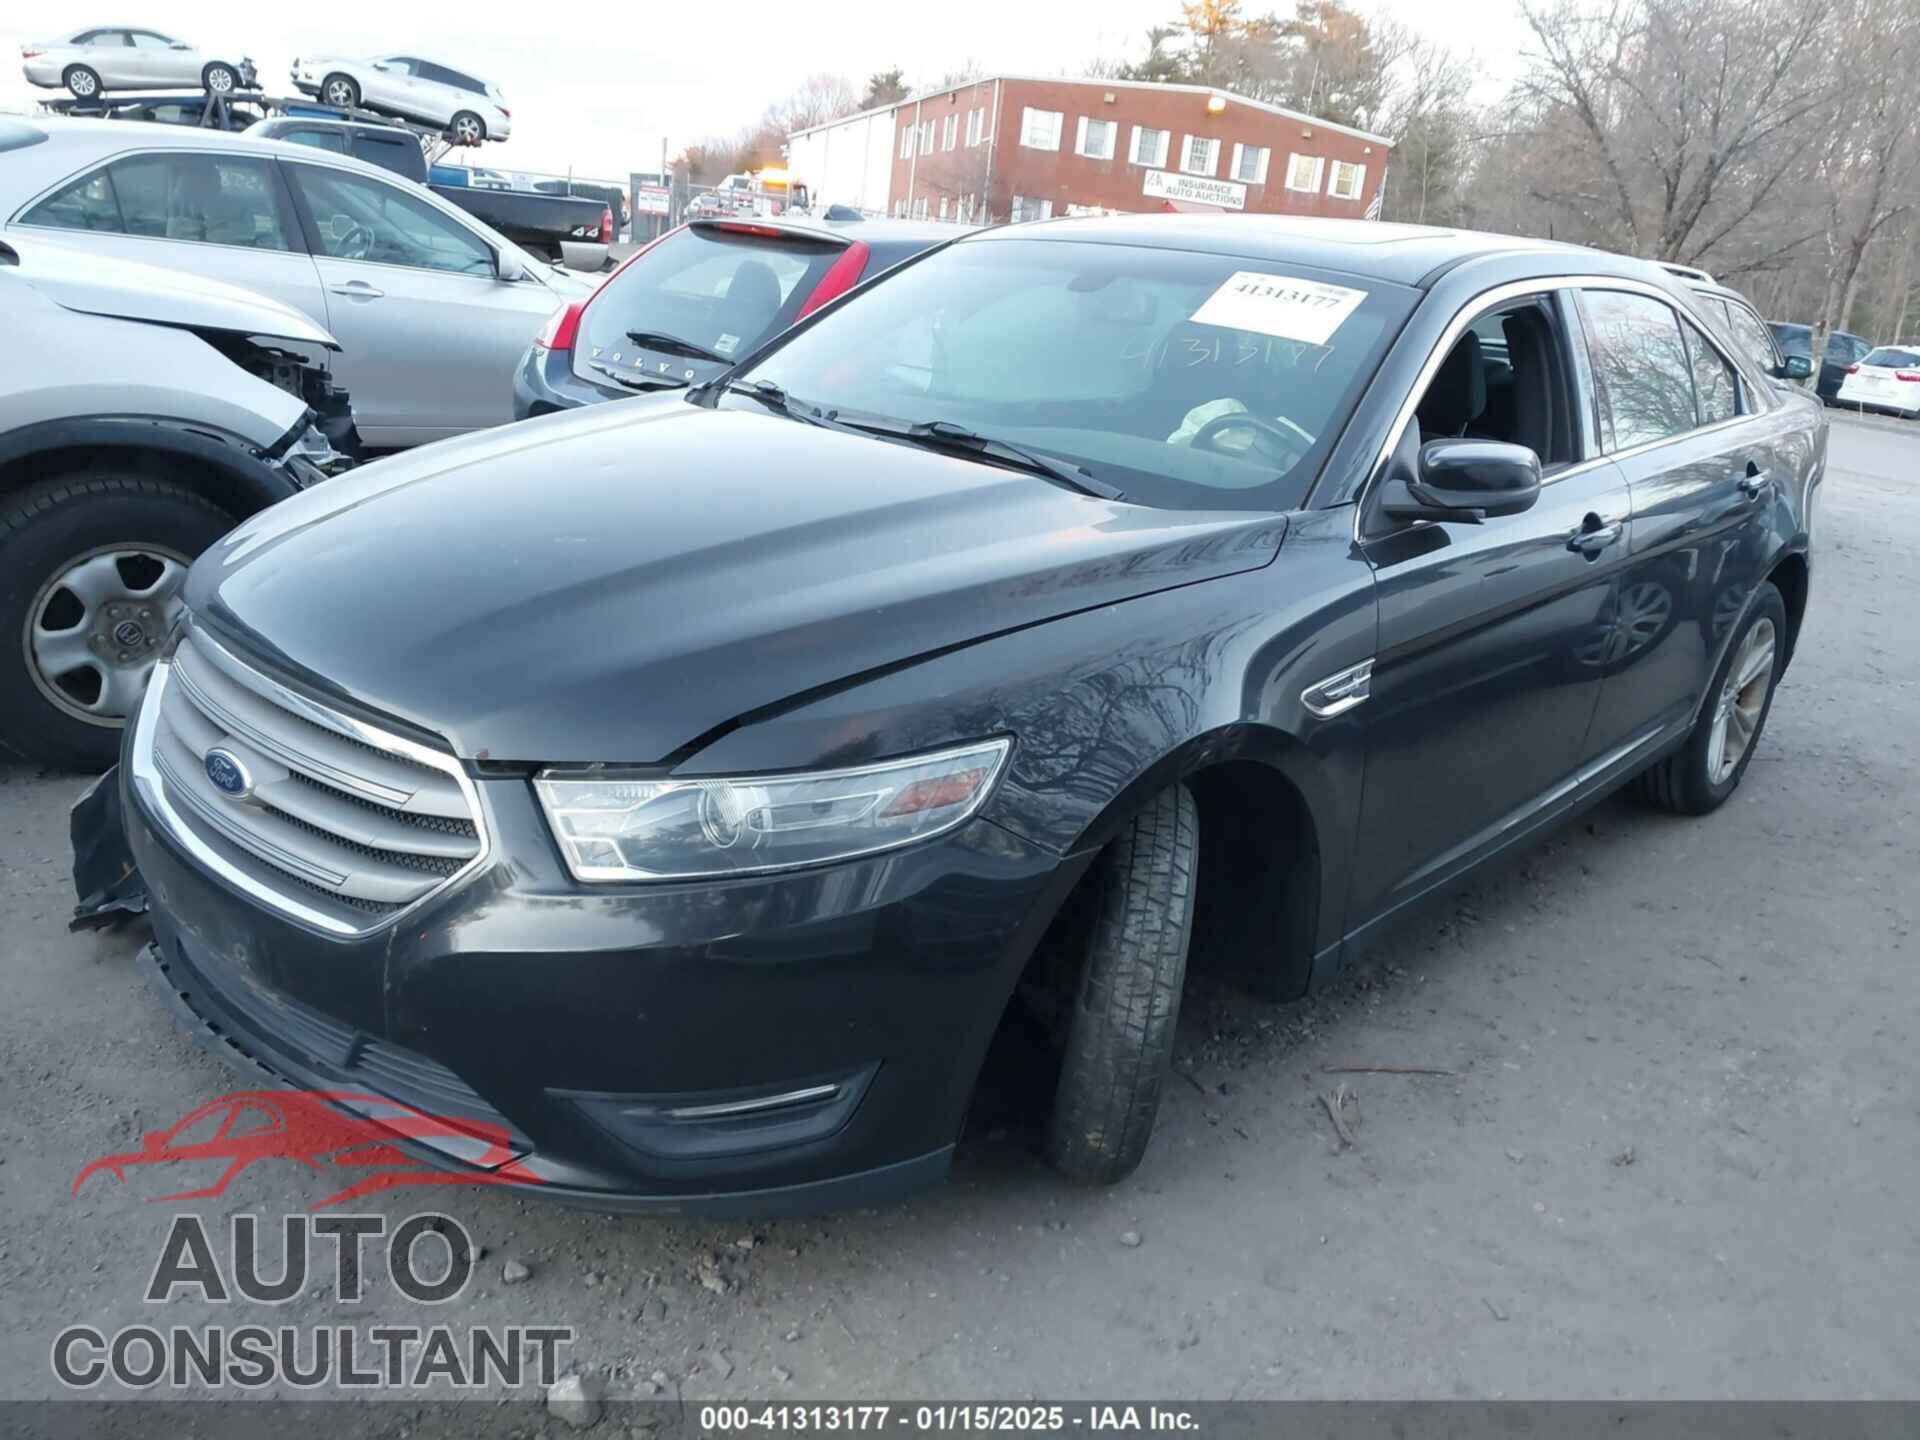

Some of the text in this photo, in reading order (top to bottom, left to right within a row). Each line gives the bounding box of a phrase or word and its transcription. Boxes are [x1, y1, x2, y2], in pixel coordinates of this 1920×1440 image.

[1166, 186, 1243, 206] AUTO AUCTIONS
[1178, 179, 1233, 194] INSURANCE
[1234, 283, 1341, 308] 41313177
[592, 347, 695, 379] VOLVO
[209, 757, 238, 789] Ford
